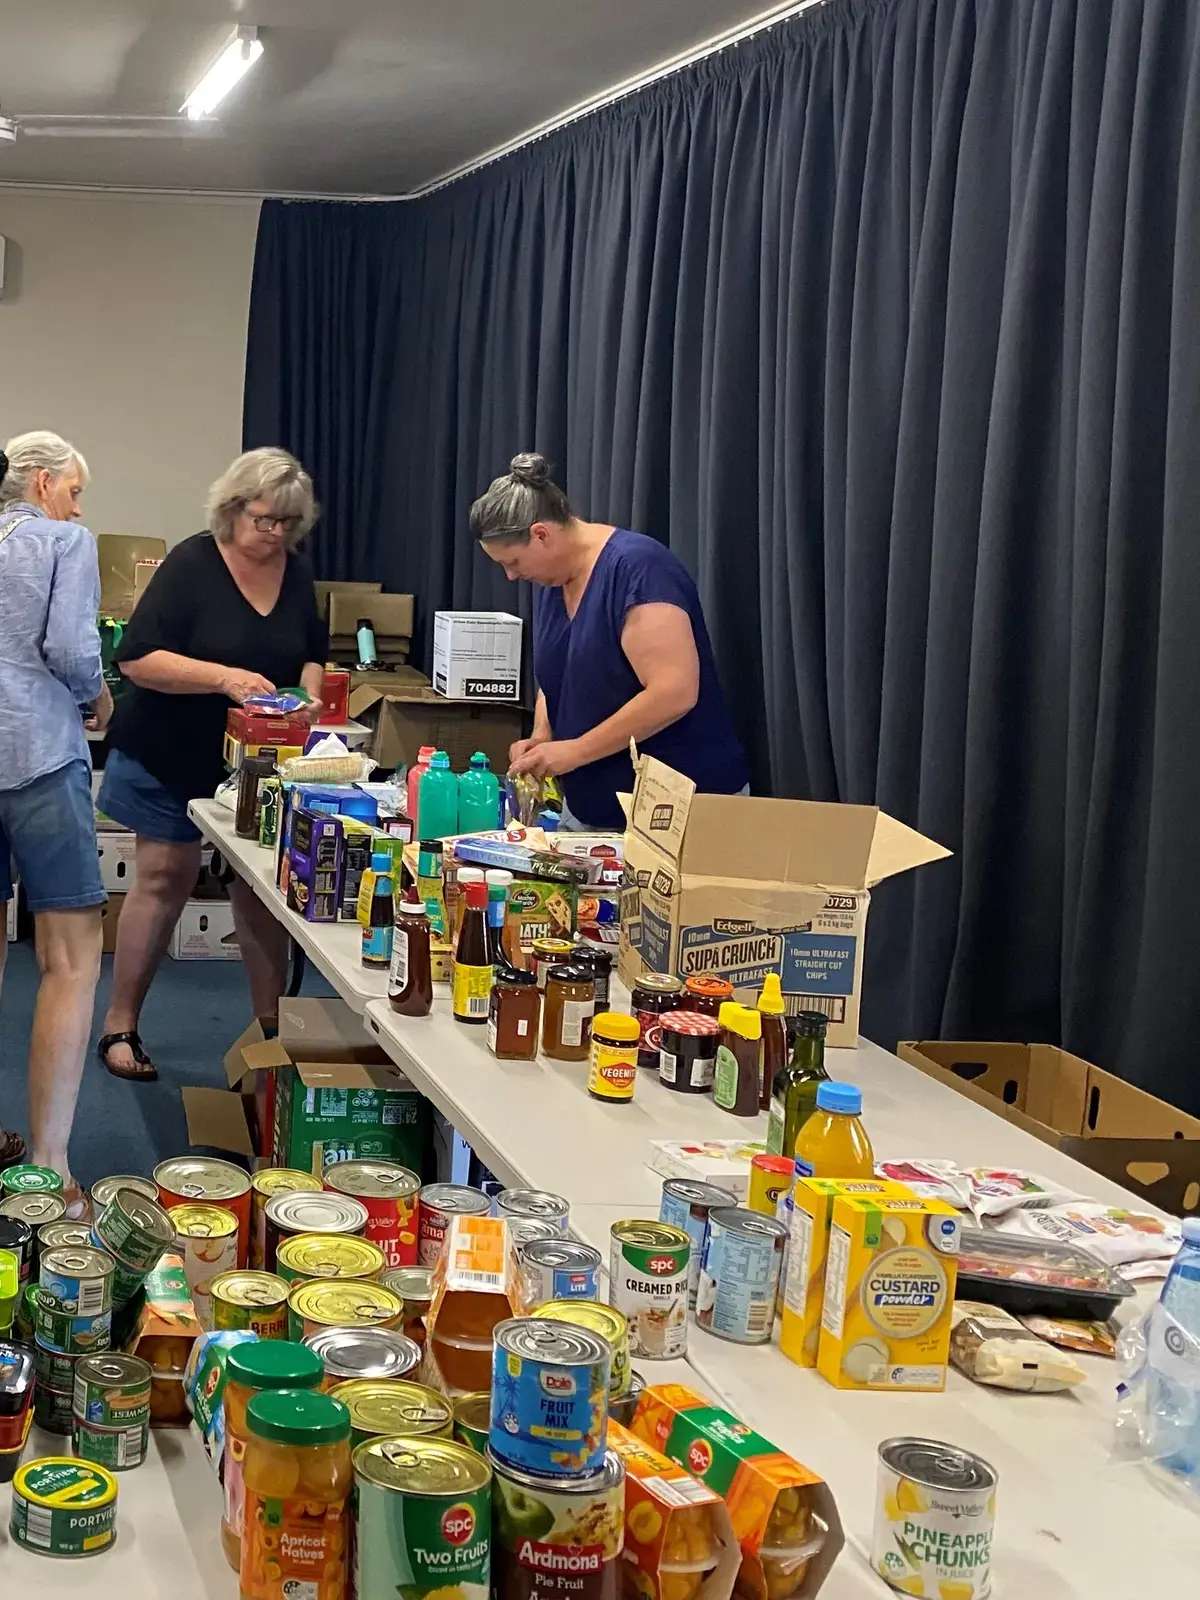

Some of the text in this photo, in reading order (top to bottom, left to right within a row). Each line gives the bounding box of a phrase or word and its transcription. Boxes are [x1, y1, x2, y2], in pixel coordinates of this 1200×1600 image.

[468, 682, 514, 694] 704882
[827, 897, 853, 908] 0729
[717, 921, 752, 934] Edgell
[721, 937, 778, 967] CRUNCH
[812, 949, 849, 959] ULTRAFAST
[650, 1258, 674, 1273] spc
[570, 1283, 586, 1292] LITE
[626, 1278, 672, 1295] CREAMED
[870, 1279, 941, 1294] CUSTARD
[879, 1294, 930, 1309] powder
[546, 1375, 572, 1391] Dole
[540, 1399, 574, 1414] FRUIT
[545, 1413, 569, 1428] MIX
[689, 1448, 709, 1468] spc
[445, 1521, 472, 1541] spc
[280, 1533, 326, 1550] Apricot
[282, 1546, 325, 1560] Halves
[413, 1542, 488, 1566] Two Fruits
[519, 1540, 599, 1571] Ardmona
[535, 1573, 584, 1590] Pie Fruit
